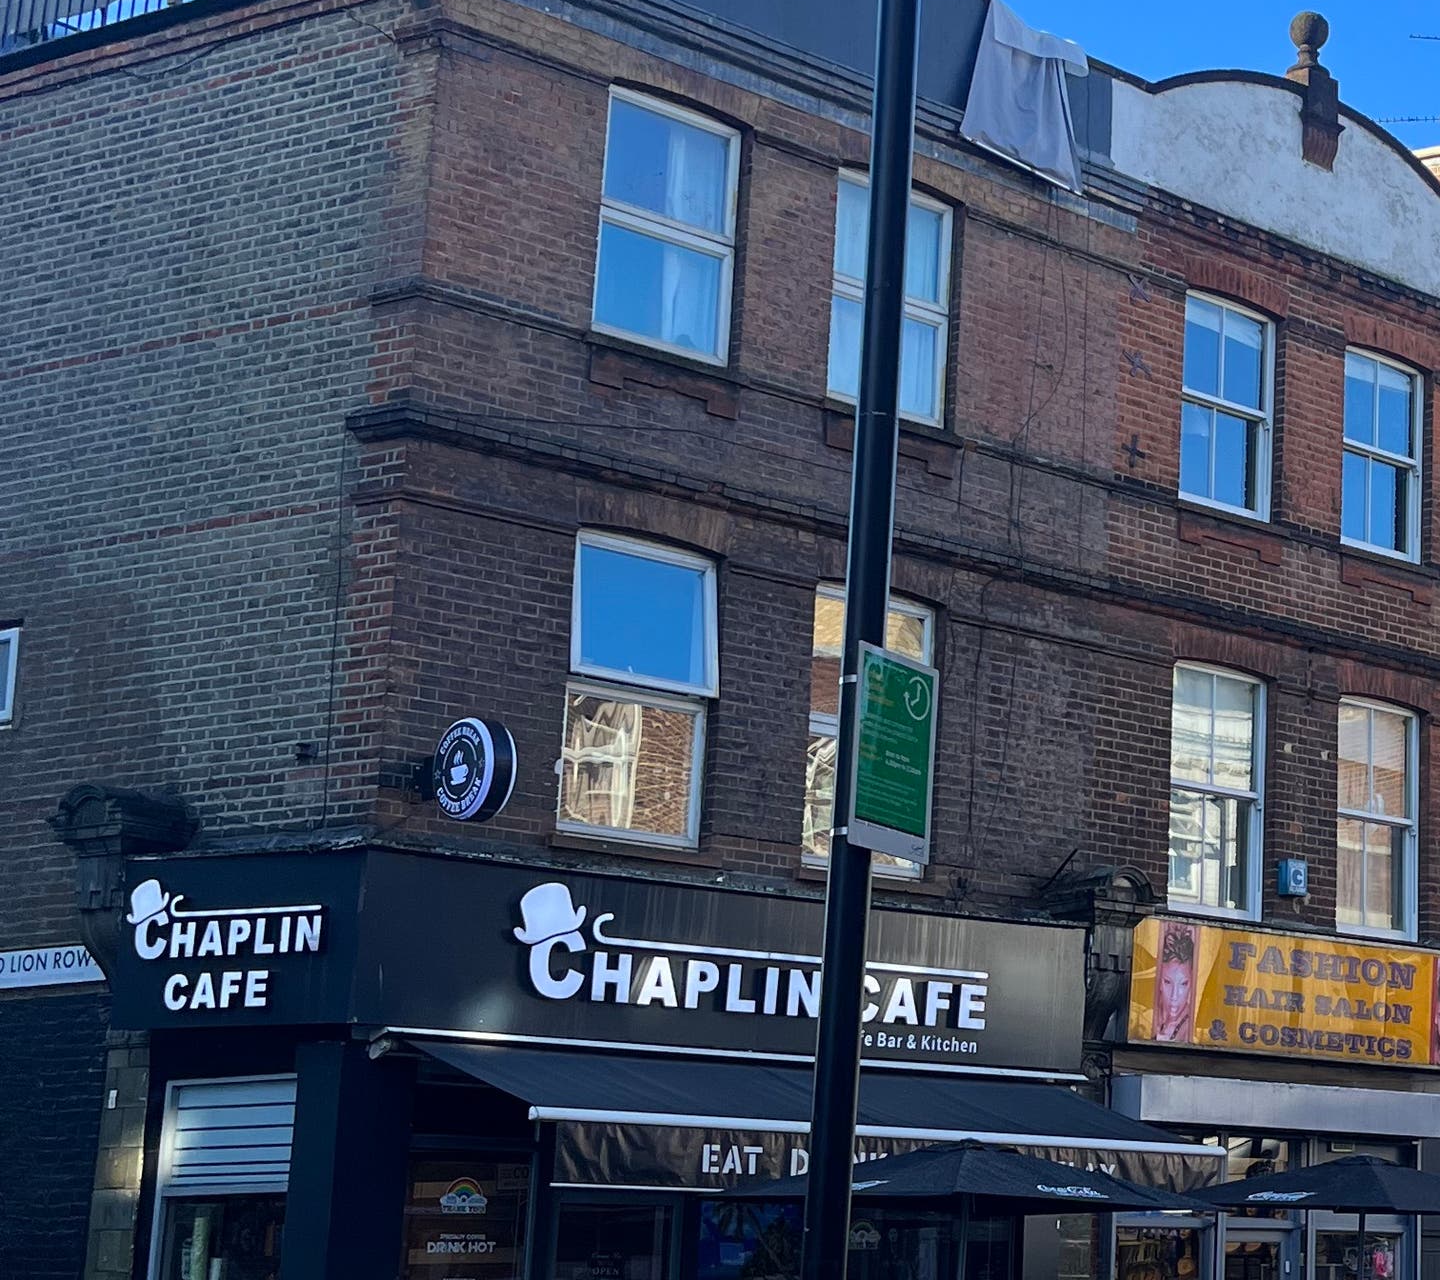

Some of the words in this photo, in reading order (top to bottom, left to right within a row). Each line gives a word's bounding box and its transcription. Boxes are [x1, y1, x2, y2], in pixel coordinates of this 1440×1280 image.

[134, 910, 322, 960] CHAPLIN
[11, 953, 48, 973] LION
[53, 949, 92, 969] ROW
[529, 930, 820, 1017] CHAPLIN
[1228, 941, 1417, 991] FASHION
[163, 970, 269, 1011] CAFE
[1224, 984, 1305, 1013] HAIR
[1314, 994, 1413, 1024] SALON
[877, 1032, 903, 1049] Bar
[906, 1033, 917, 1050] &
[921, 1035, 978, 1054] Kitchen
[1208, 1018, 1228, 1041] &
[1238, 1022, 1413, 1059] COSMETICS
[702, 1143, 764, 1175] EAT
[427, 1241, 466, 1253] DRINK
[468, 1241, 496, 1253] HOT
